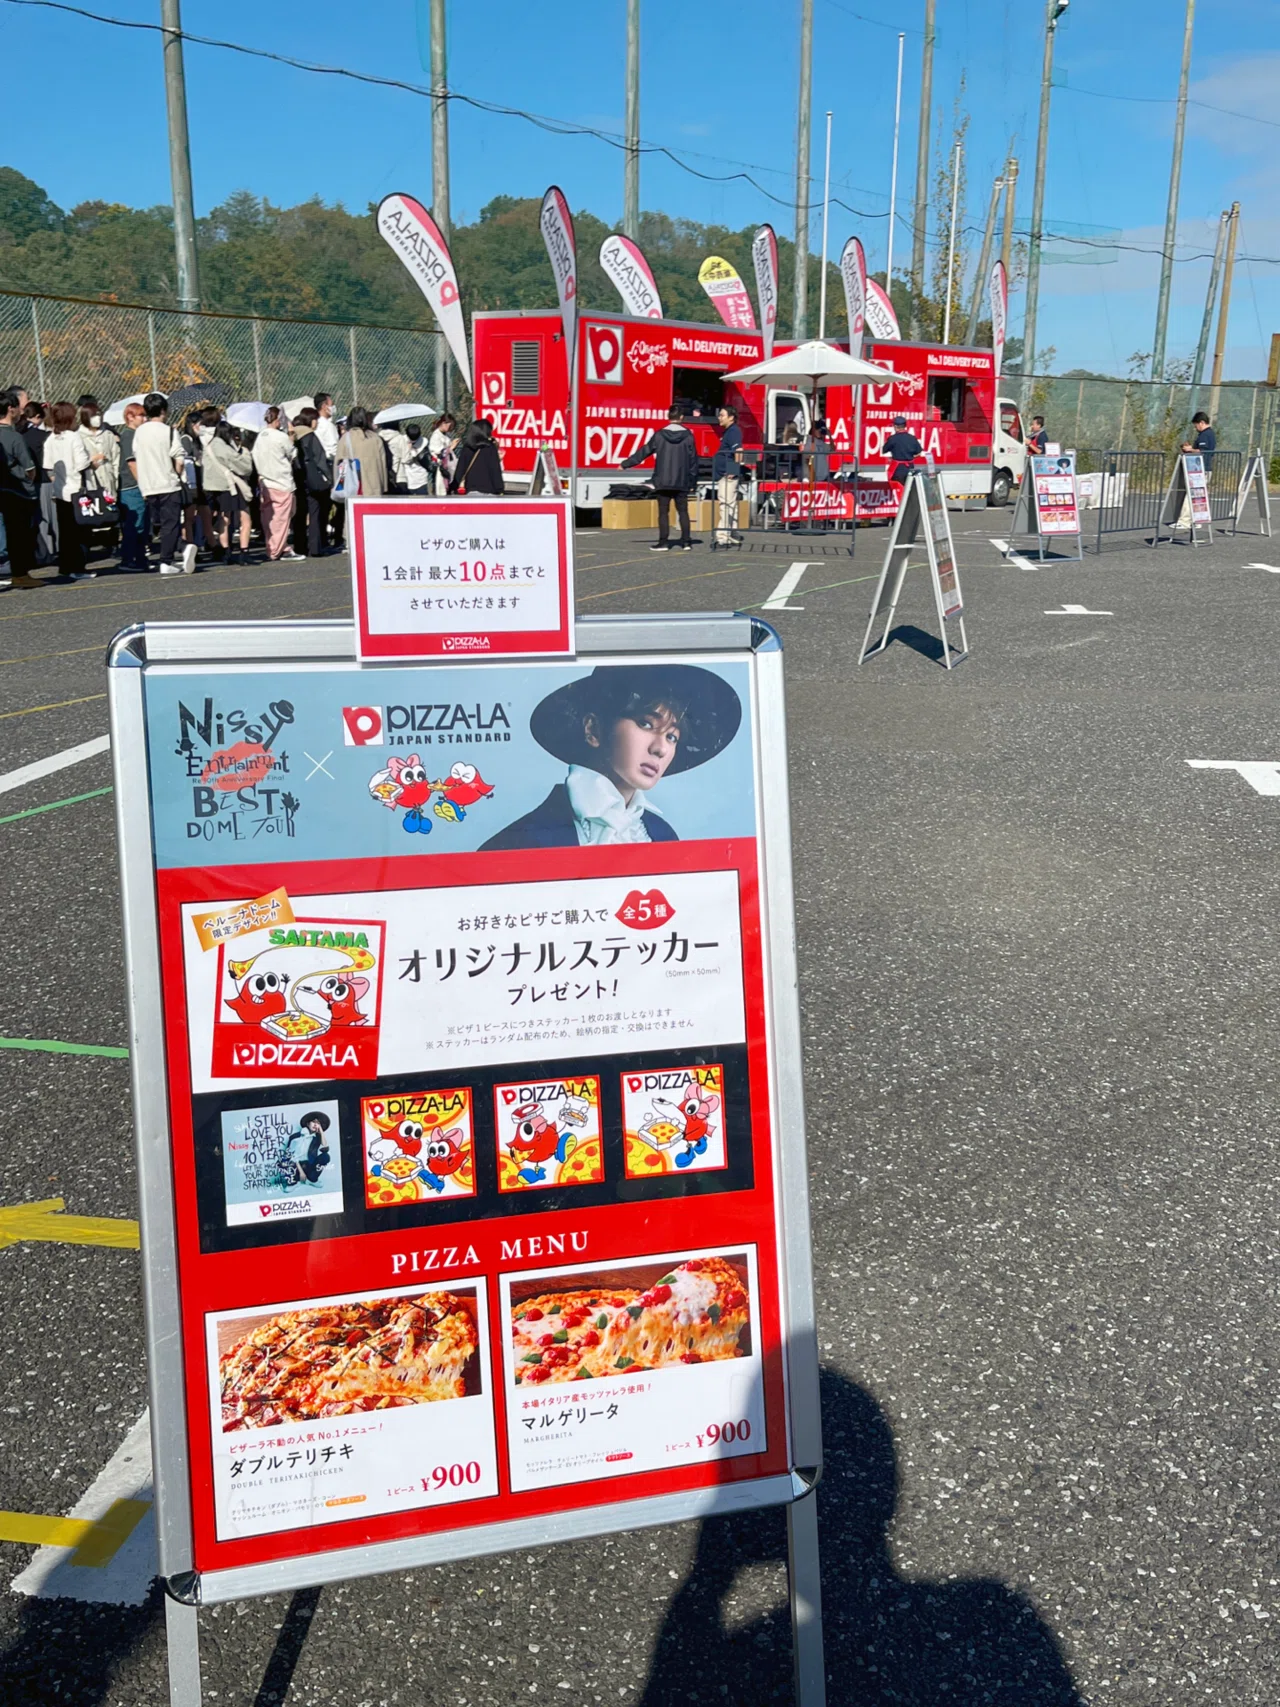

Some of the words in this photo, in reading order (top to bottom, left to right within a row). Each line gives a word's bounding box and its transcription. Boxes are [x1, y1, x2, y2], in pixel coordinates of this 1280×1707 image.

[673, 338, 692, 352] No.1
[694, 340, 733, 356] DELIVERY
[734, 344, 759, 358] PIZZA
[943, 355, 971, 367] DELIVERY
[972, 358, 990, 368] PIZZA
[585, 406, 617, 418] JAPAN
[866, 410, 888, 420] JAPAN
[420, 538, 506, 551] ピザのご購入は
[410, 596, 520, 610] させていただきます
[454, 636, 490, 646] PIZZA-LA
[178, 697, 294, 752] Nissy
[386, 702, 511, 732] PIZZA-LA
[389, 734, 433, 746] JAPAN
[438, 731, 511, 744] STANDARD
[266, 774, 285, 782] Final
[193, 783, 280, 818] BEST
[186, 811, 246, 842] DOME
[251, 806, 295, 839] TOUR
[203, 898, 281, 929] ベルーナドーム
[457, 908, 609, 932] お好きなピザご購入で
[268, 929, 369, 948] SAITAMA
[398, 931, 719, 983] オリジナルステッカー
[258, 1043, 359, 1067] PIZZA-LA
[645, 1070, 717, 1092] PIZZA-LA
[519, 1082, 592, 1105] PIZZA-LA
[387, 1093, 465, 1118] PIZZA-LA
[254, 1113, 288, 1127] STILL
[244, 1126, 272, 1141] LOVE
[274, 1124, 294, 1137] YOU
[252, 1136, 286, 1151] AFTER
[243, 1152, 257, 1164] 10
[244, 1169, 263, 1179] YOUR
[243, 1178, 271, 1190] STARTS
[272, 1199, 311, 1212] PIZZA-LA
[391, 1244, 481, 1274] PIZZA
[500, 1230, 588, 1260] MENU
[521, 1402, 620, 1431] マルゲリータ
[523, 1431, 573, 1444] MARGHERITA
[695, 1418, 751, 1449] ¥900
[229, 1442, 354, 1479] ダブルテリチキ
[231, 1479, 264, 1490] DOUBLE
[420, 1461, 481, 1493] ¥900
